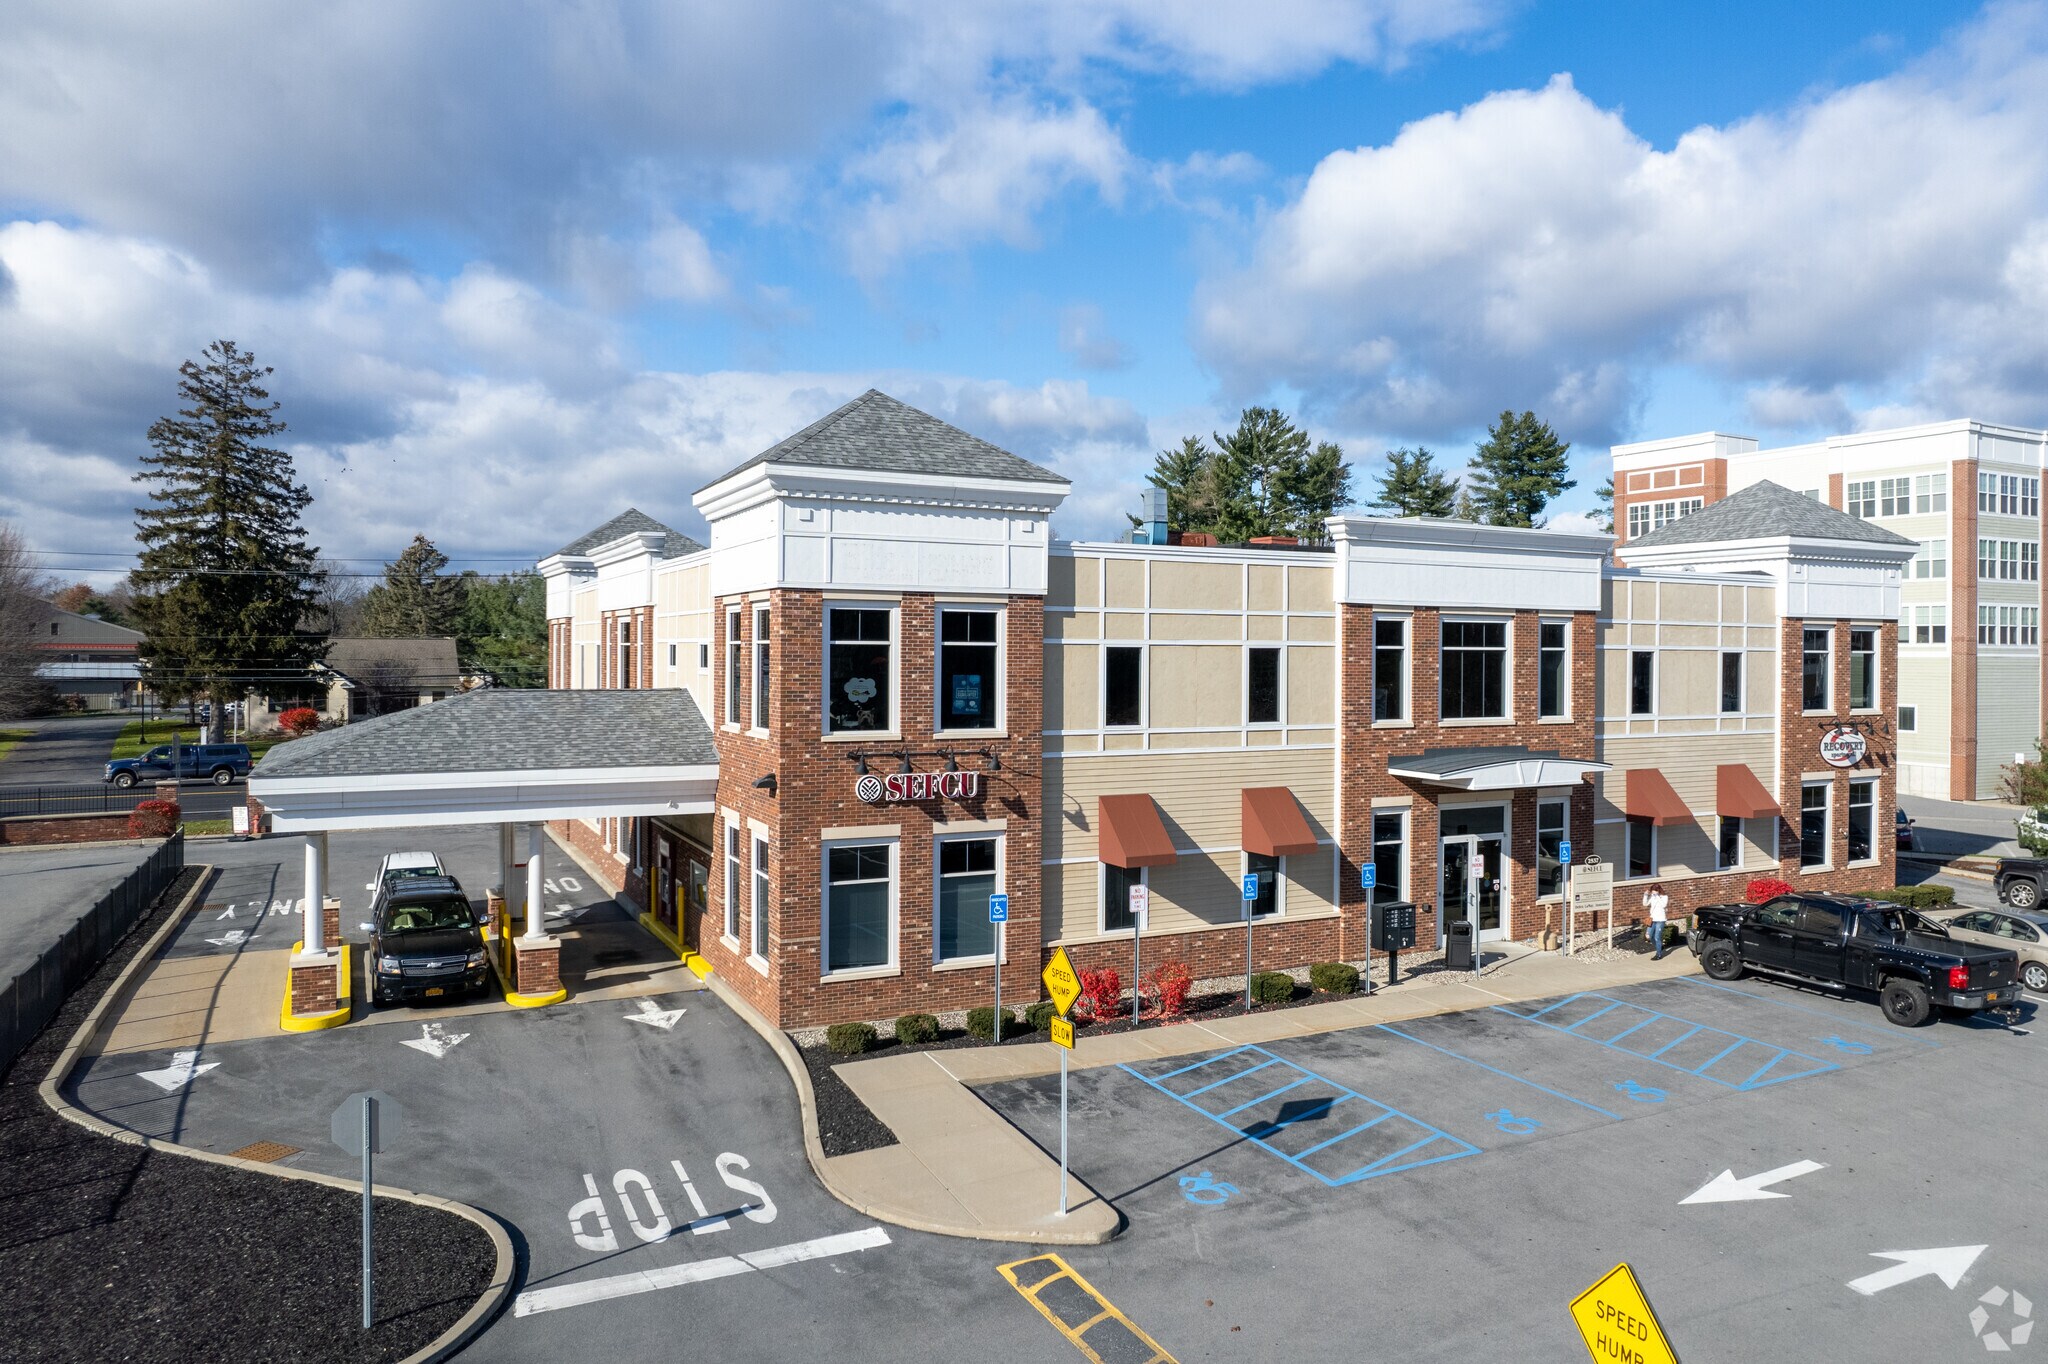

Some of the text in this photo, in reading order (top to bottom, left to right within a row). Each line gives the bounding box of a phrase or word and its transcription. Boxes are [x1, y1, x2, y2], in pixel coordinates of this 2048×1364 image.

[1823, 741, 1864, 751] RECOVERY
[885, 771, 980, 801] SEFCU
[1051, 967, 1071, 983] SPEED
[1052, 983, 1071, 998] HUMP
[1053, 1024, 1071, 1041] SLOW
[567, 1152, 778, 1252] STOP
[1595, 1299, 1648, 1342] SPEED
